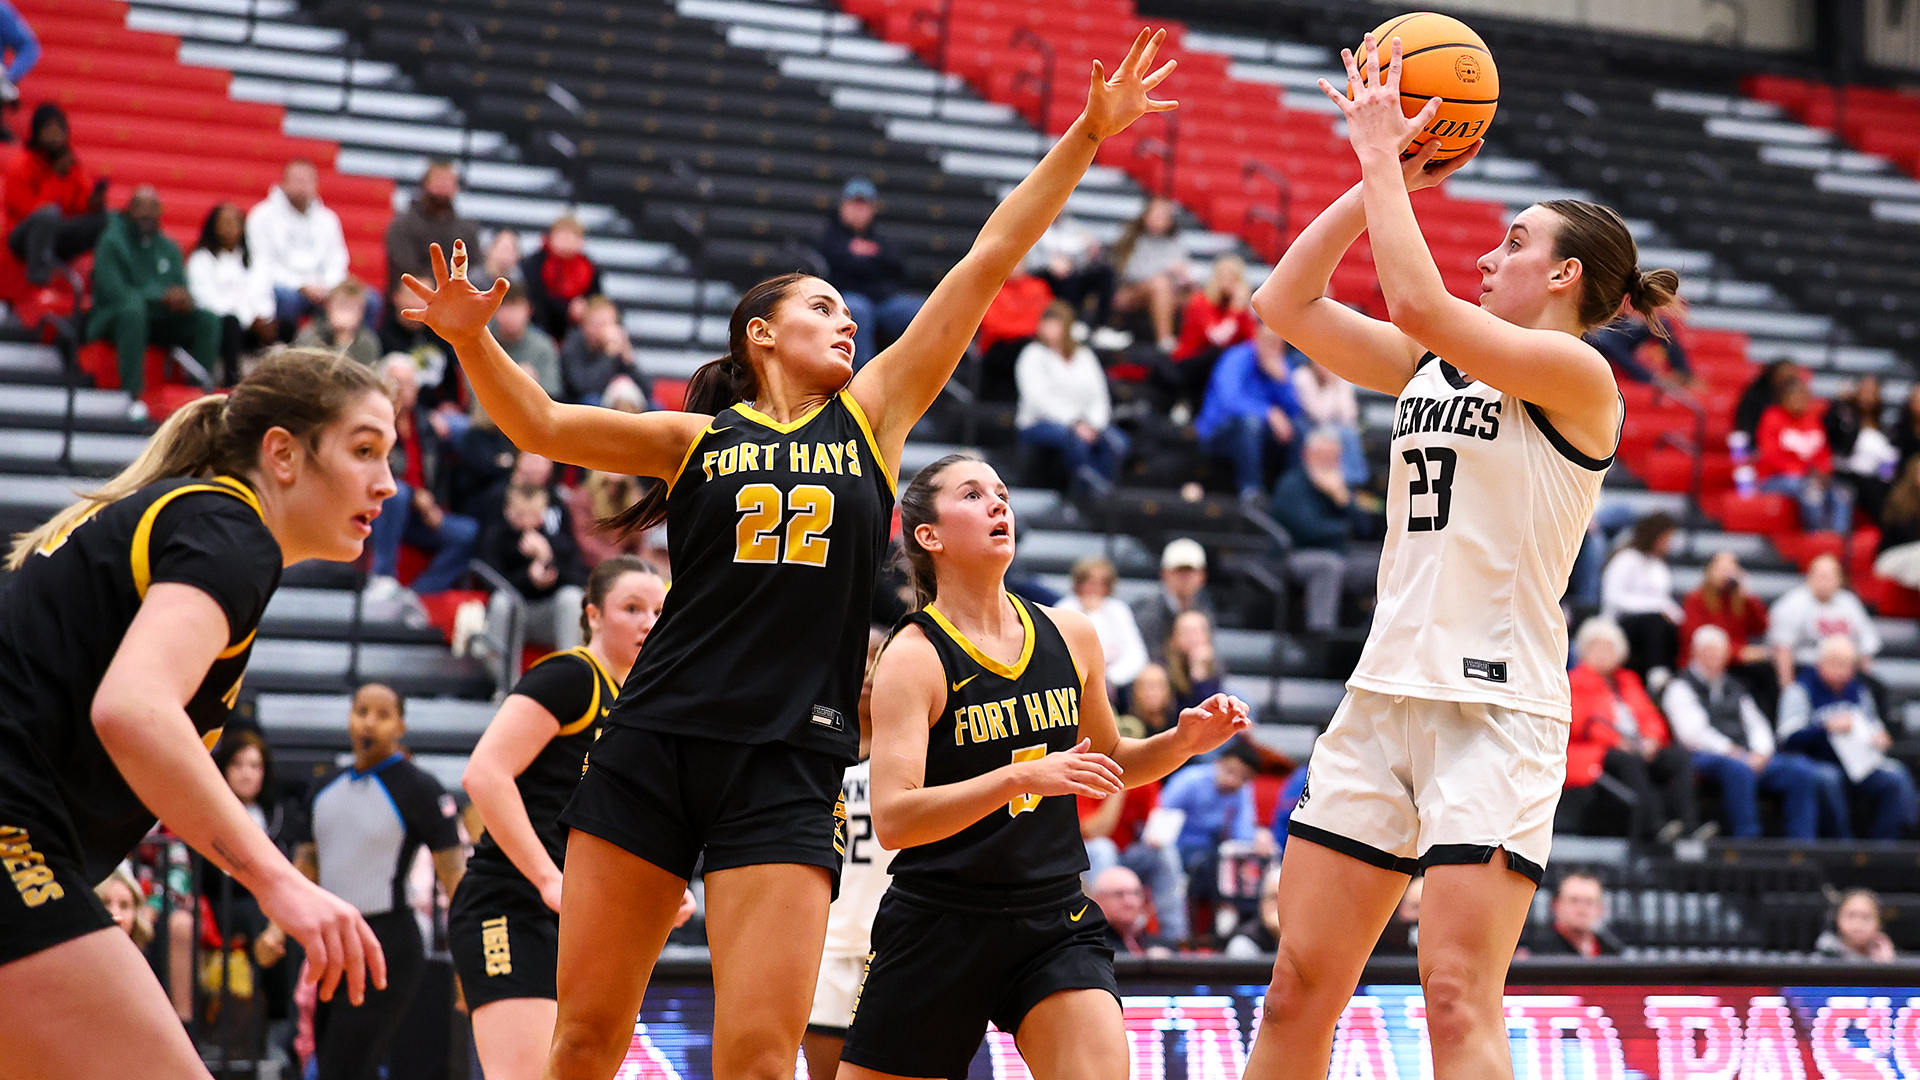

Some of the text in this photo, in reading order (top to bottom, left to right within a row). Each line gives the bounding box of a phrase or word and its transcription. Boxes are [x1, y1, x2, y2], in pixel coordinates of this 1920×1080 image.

[1393, 396, 1502, 441] JENNIES
[702, 439, 863, 482] FORT HAYS
[1402, 447, 1457, 532] 23
[733, 483, 835, 568] 22
[954, 687, 1079, 746] FORT HAYS
